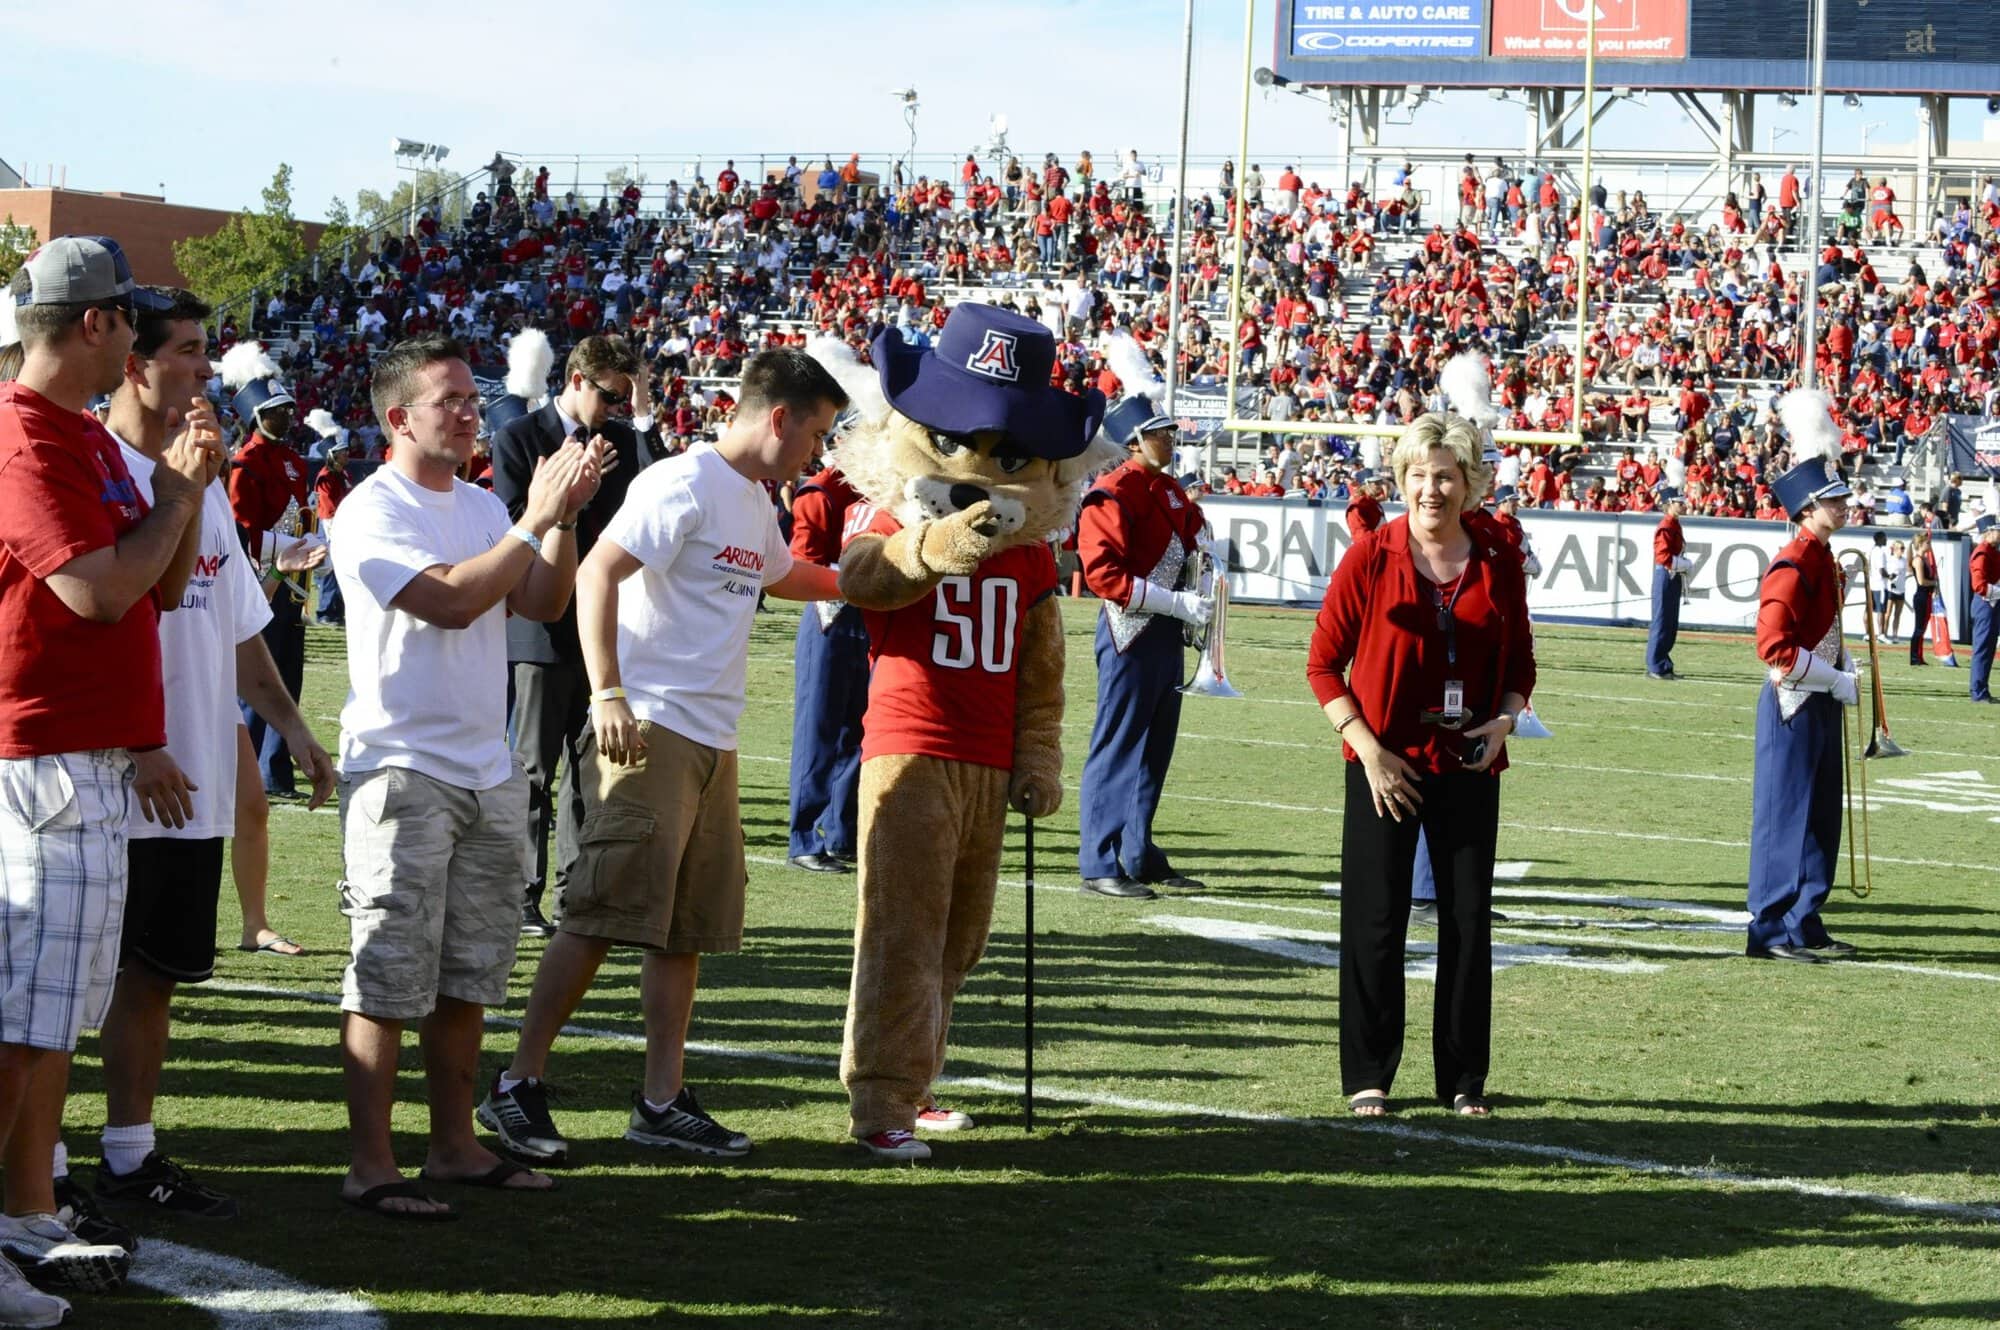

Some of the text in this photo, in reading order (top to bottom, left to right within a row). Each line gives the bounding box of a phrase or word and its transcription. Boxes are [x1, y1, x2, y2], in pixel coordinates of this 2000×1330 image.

[1305, 6, 1471, 20] TIRE & AUTO CARE
[1504, 37, 1541, 49] What
[1544, 37, 1573, 49] else
[1598, 38, 1624, 51] you
[1627, 36, 1673, 49] need?
[1905, 24, 1936, 53] at
[966, 329, 1020, 382] A
[1201, 400, 1227, 409] FAMIL
[1542, 534, 1886, 607] ARZOA
[932, 576, 1018, 673] 50
